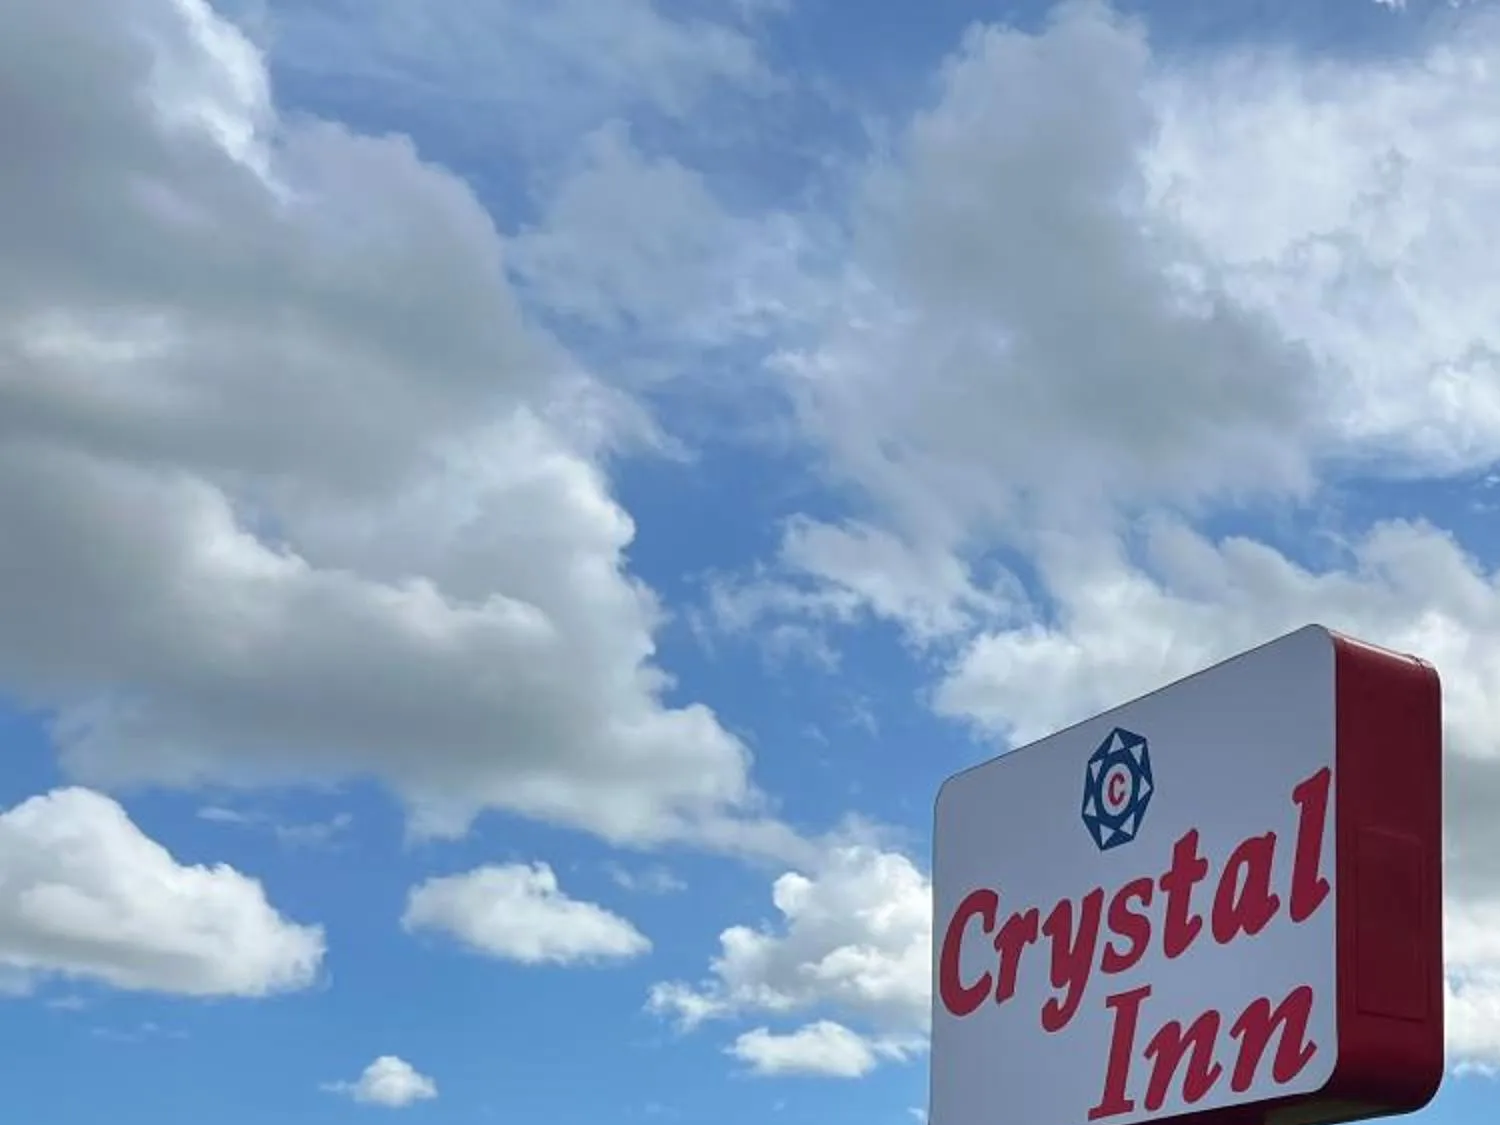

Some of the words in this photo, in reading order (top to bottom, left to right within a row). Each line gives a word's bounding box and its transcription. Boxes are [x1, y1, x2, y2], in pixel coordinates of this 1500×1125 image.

[1107, 772, 1126, 807] C
[938, 767, 1331, 1033] Crystal
[1087, 984, 1317, 1122] Inn
